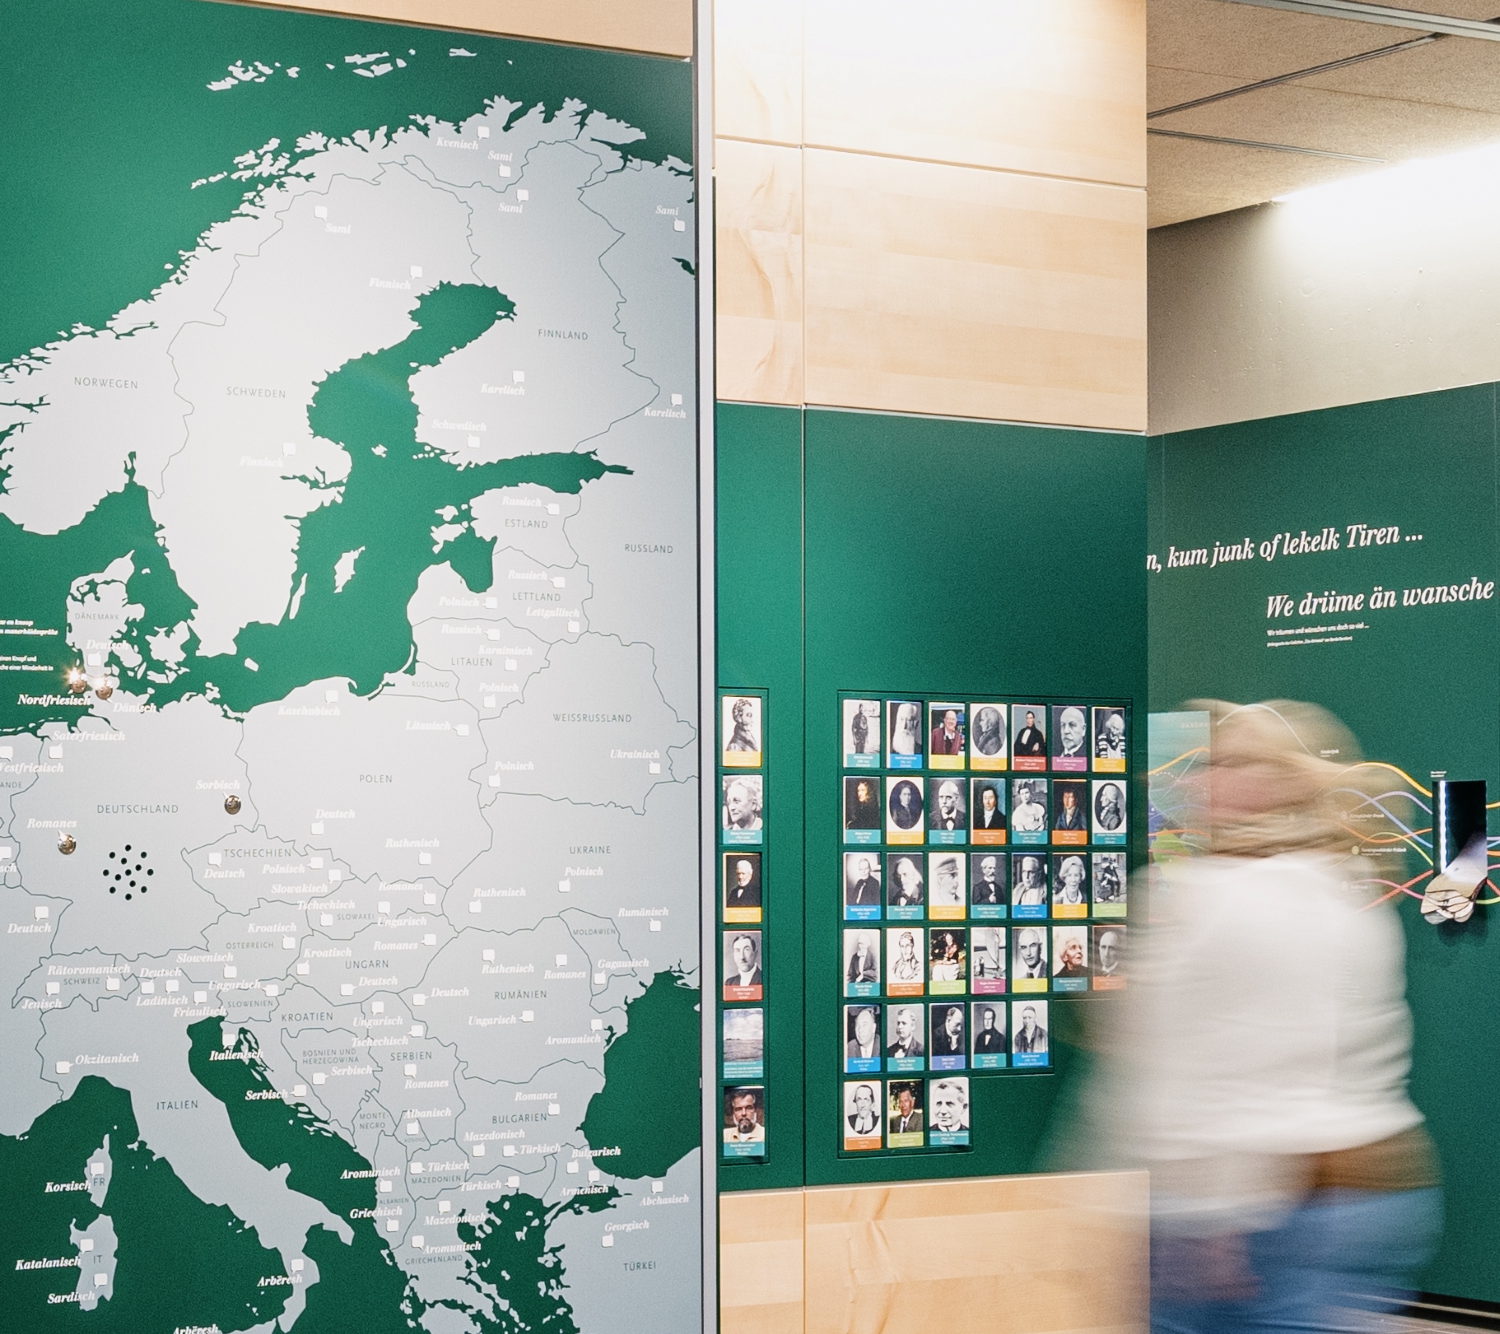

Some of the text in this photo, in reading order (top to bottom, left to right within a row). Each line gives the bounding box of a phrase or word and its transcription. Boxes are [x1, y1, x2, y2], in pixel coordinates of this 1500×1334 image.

[538, 328, 588, 341] FINNLAND
[74, 376, 139, 389] NORWEGEN
[226, 386, 286, 399] SCHWEDEN
[624, 543, 674, 554] RUSSLAND
[1167, 546, 1208, 567] kum
[1210, 539, 1254, 567] junk
[1259, 536, 1282, 561] of
[1282, 531, 1339, 554] lekelk
[1346, 526, 1400, 547] Tiren
[1266, 594, 1294, 618] We
[1298, 590, 1364, 615] driime
[1369, 586, 1396, 609] än
[1402, 576, 1494, 606] wansche
[18, 694, 91, 707] Nordfriesisch
[359, 774, 393, 784] POLEN
[97, 804, 179, 814] DEUTSCHLAND
[27, 818, 77, 829] Romanes
[569, 845, 611, 855] UKRAINE
[494, 989, 547, 1001] RUMÄNIEN
[156, 1099, 199, 1111] ITALIEN
[492, 1112, 548, 1124] BULGARIEN
[623, 1261, 656, 1271] TÜRKEI
